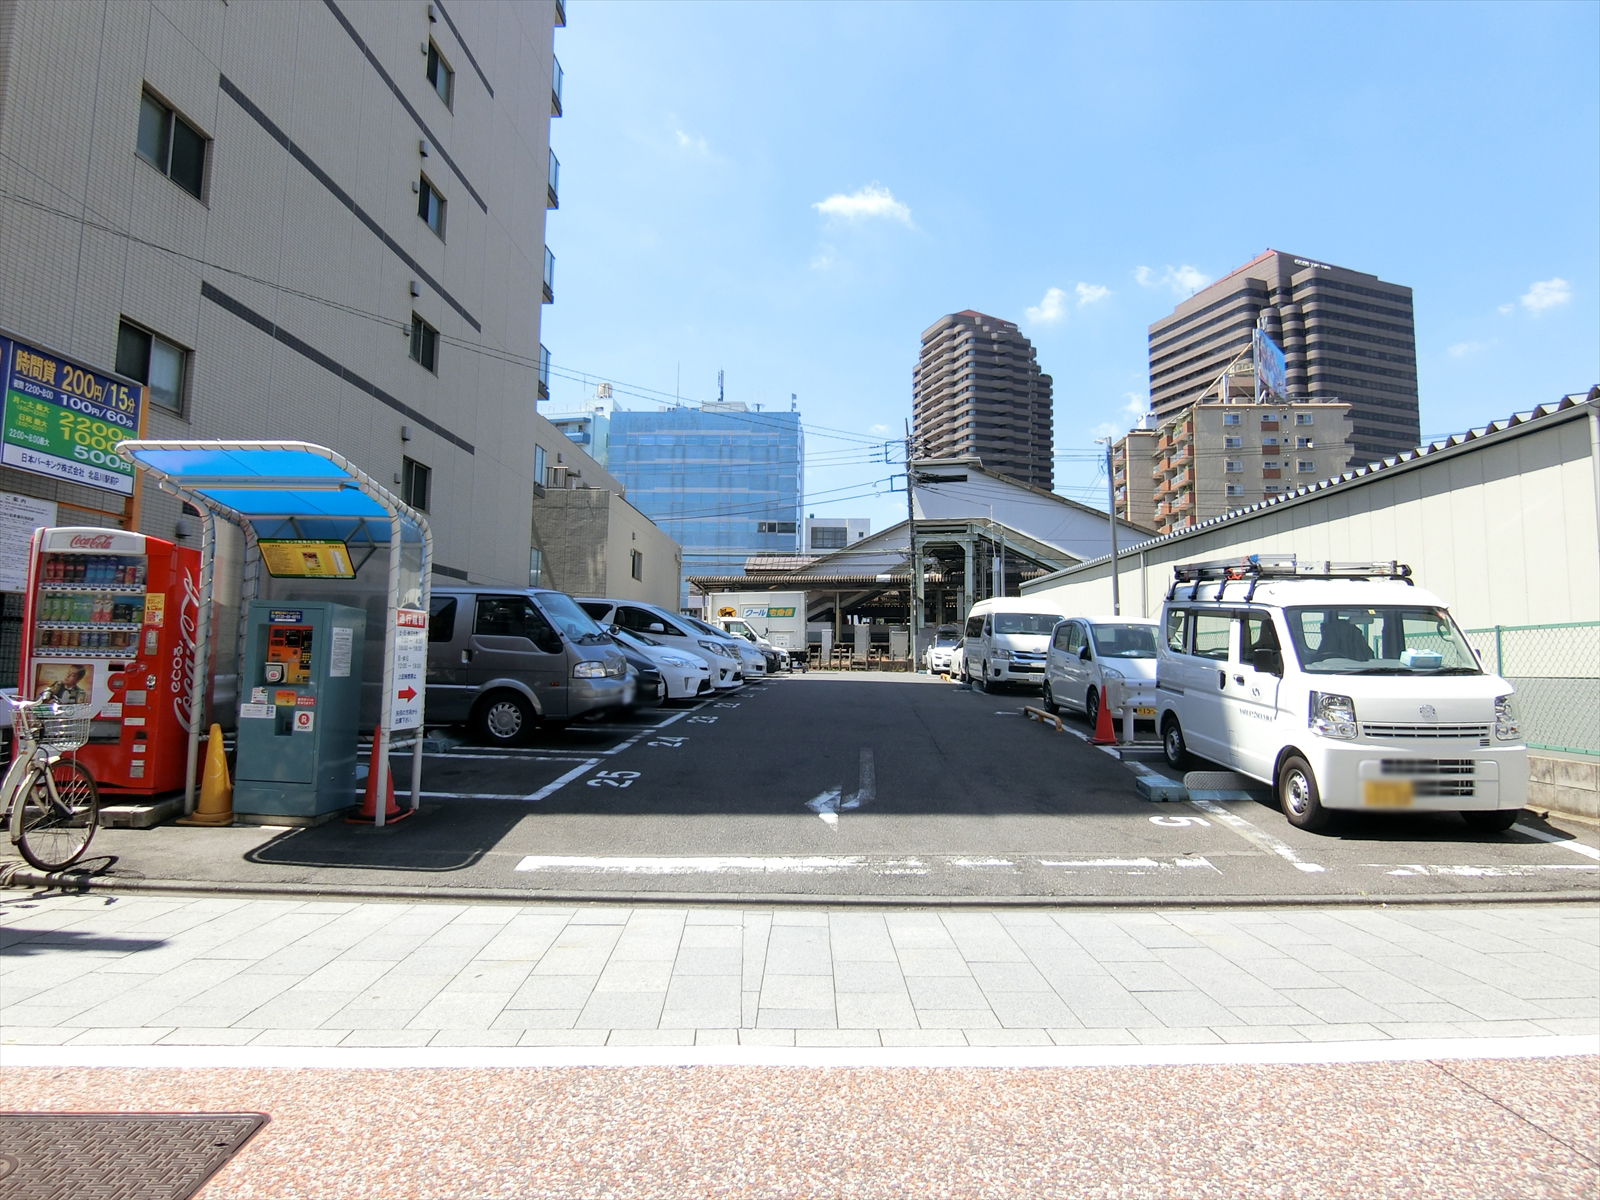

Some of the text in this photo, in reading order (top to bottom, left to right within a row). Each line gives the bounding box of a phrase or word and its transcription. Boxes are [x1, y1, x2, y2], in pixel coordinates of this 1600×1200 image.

[15, 350, 57, 385] 時間貸
[21, 452, 85, 478] 日本パーキング株式会社
[74, 445, 131, 472] 500円
[746, 609, 793, 617] クール 宅急便
[647, 736, 690, 747] 24
[587, 770, 641, 788] 25
[1148, 816, 1211, 827] 5
